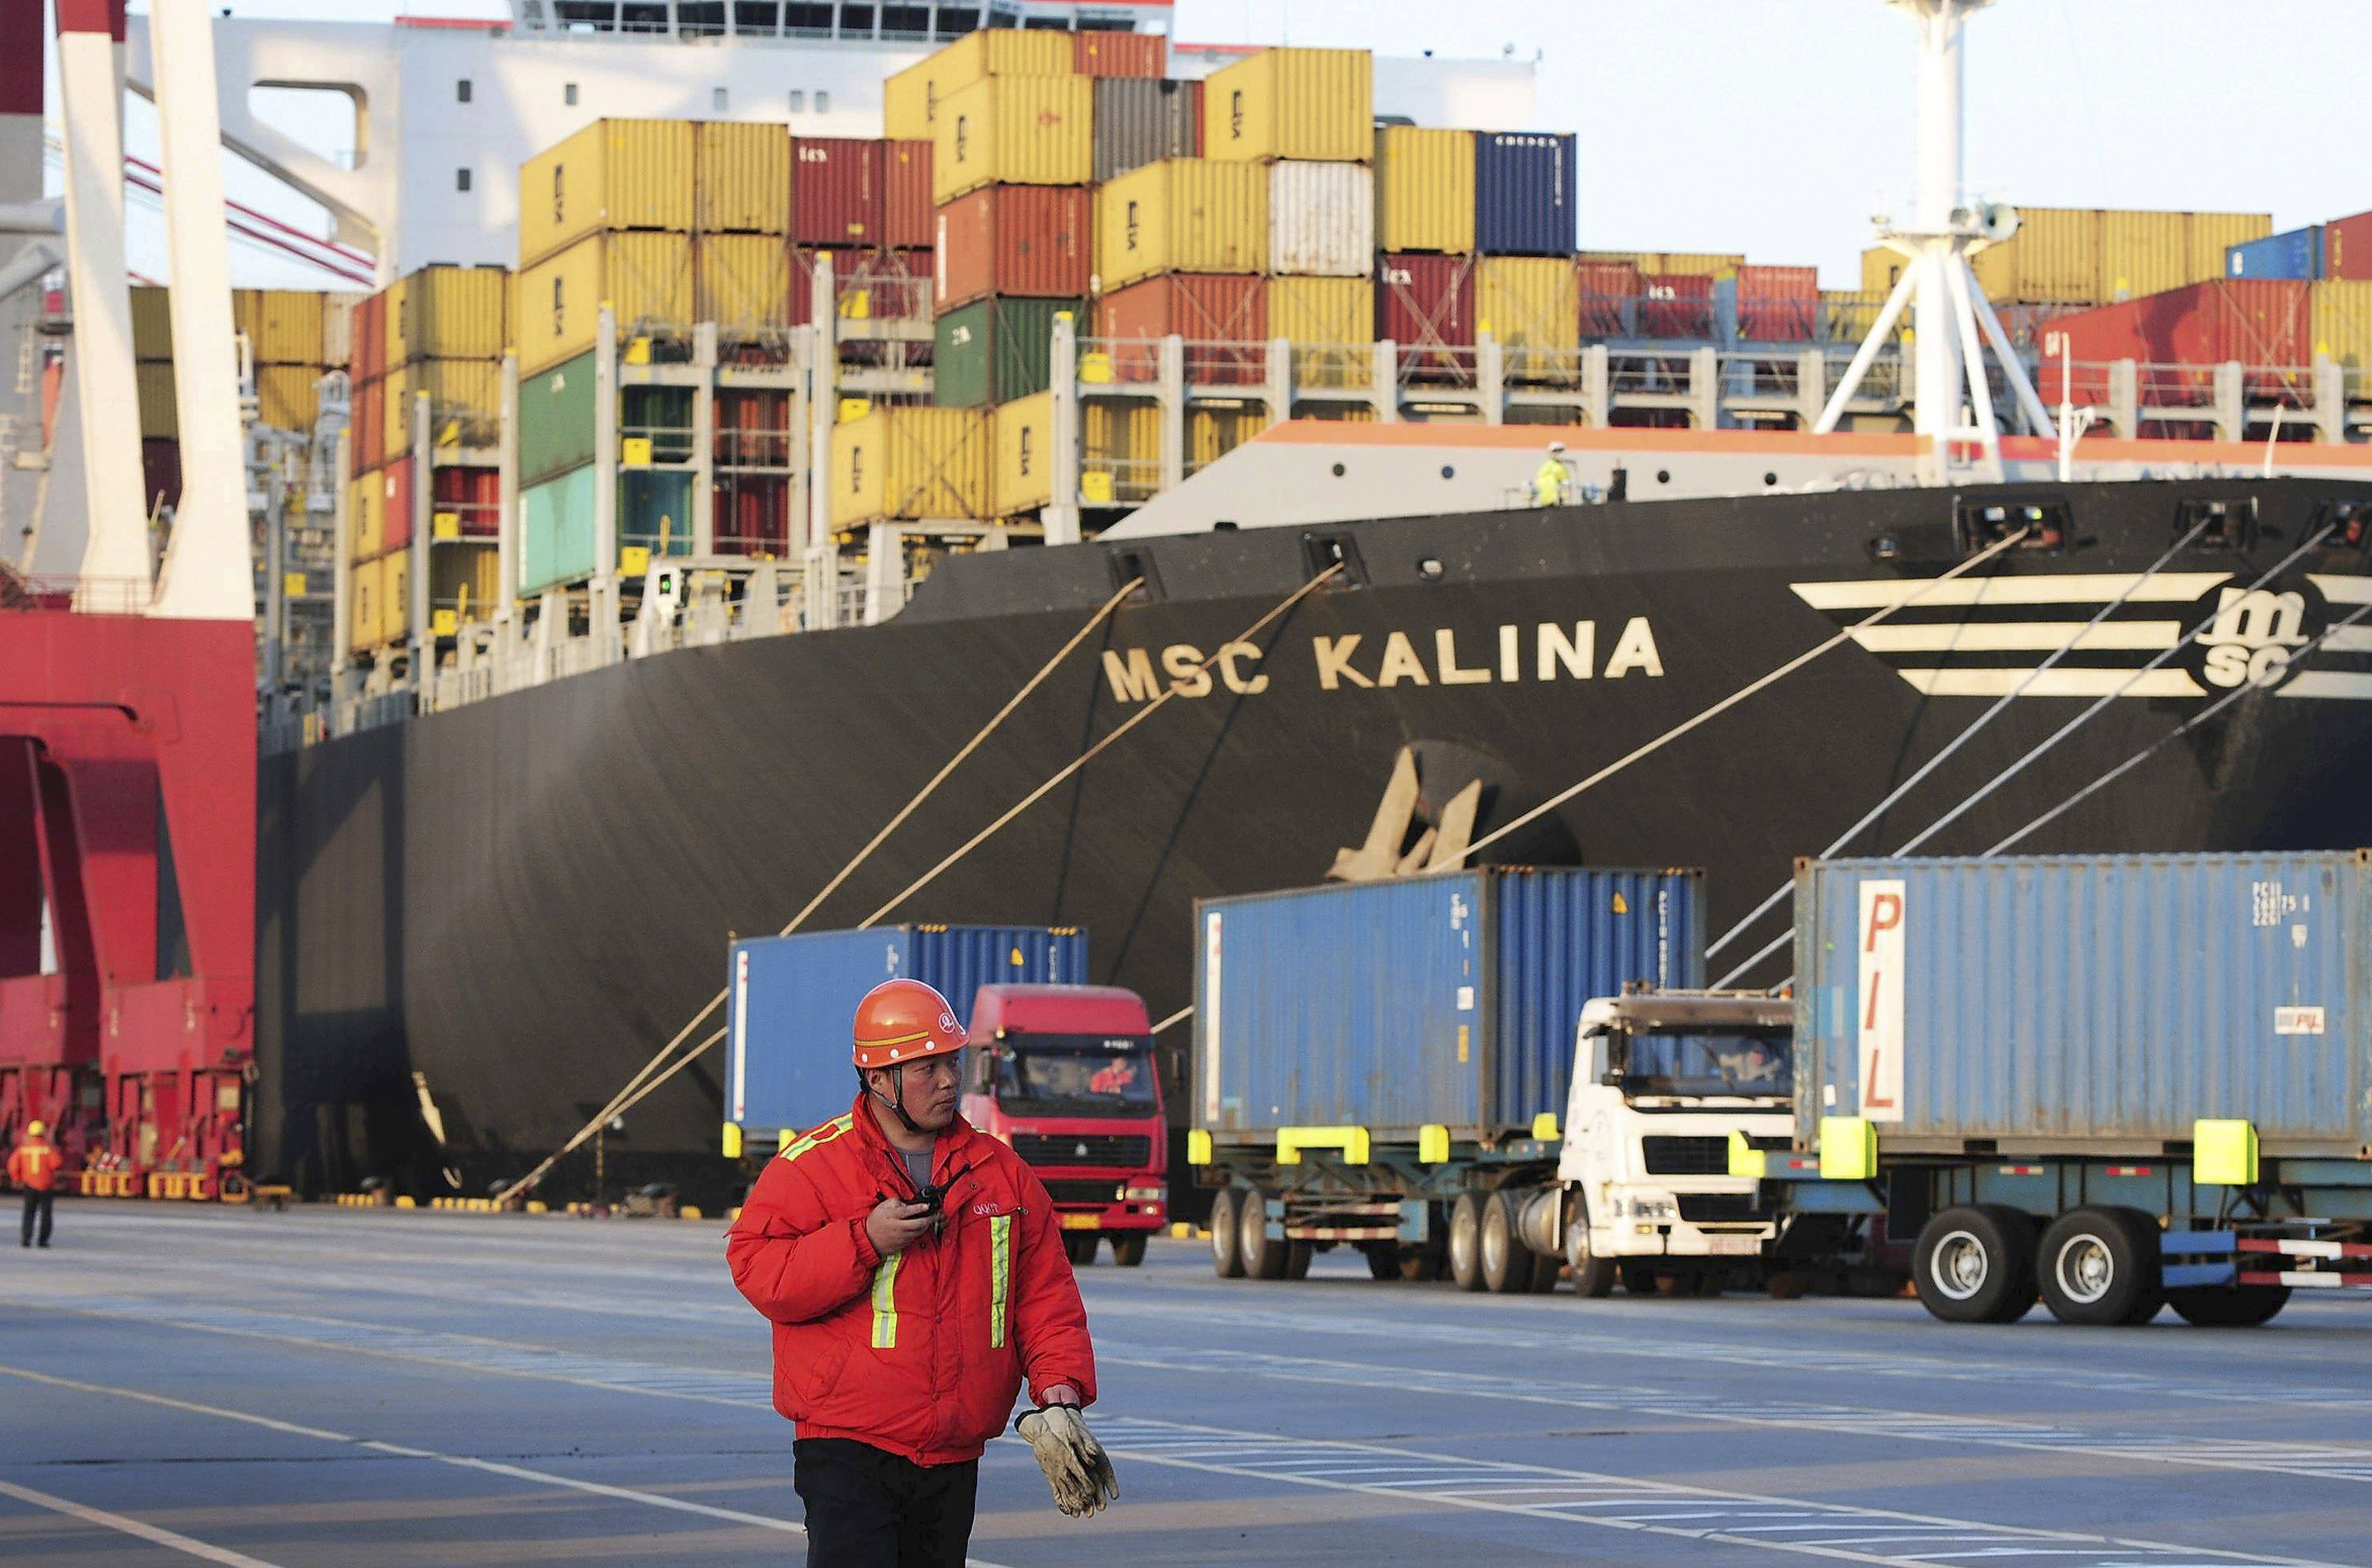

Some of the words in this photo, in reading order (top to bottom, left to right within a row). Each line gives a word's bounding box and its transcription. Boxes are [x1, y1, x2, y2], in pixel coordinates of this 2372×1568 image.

[1102, 640, 1270, 703] MSC
[1313, 617, 1664, 690] KALINA
[1865, 894, 1901, 1107] PIL
